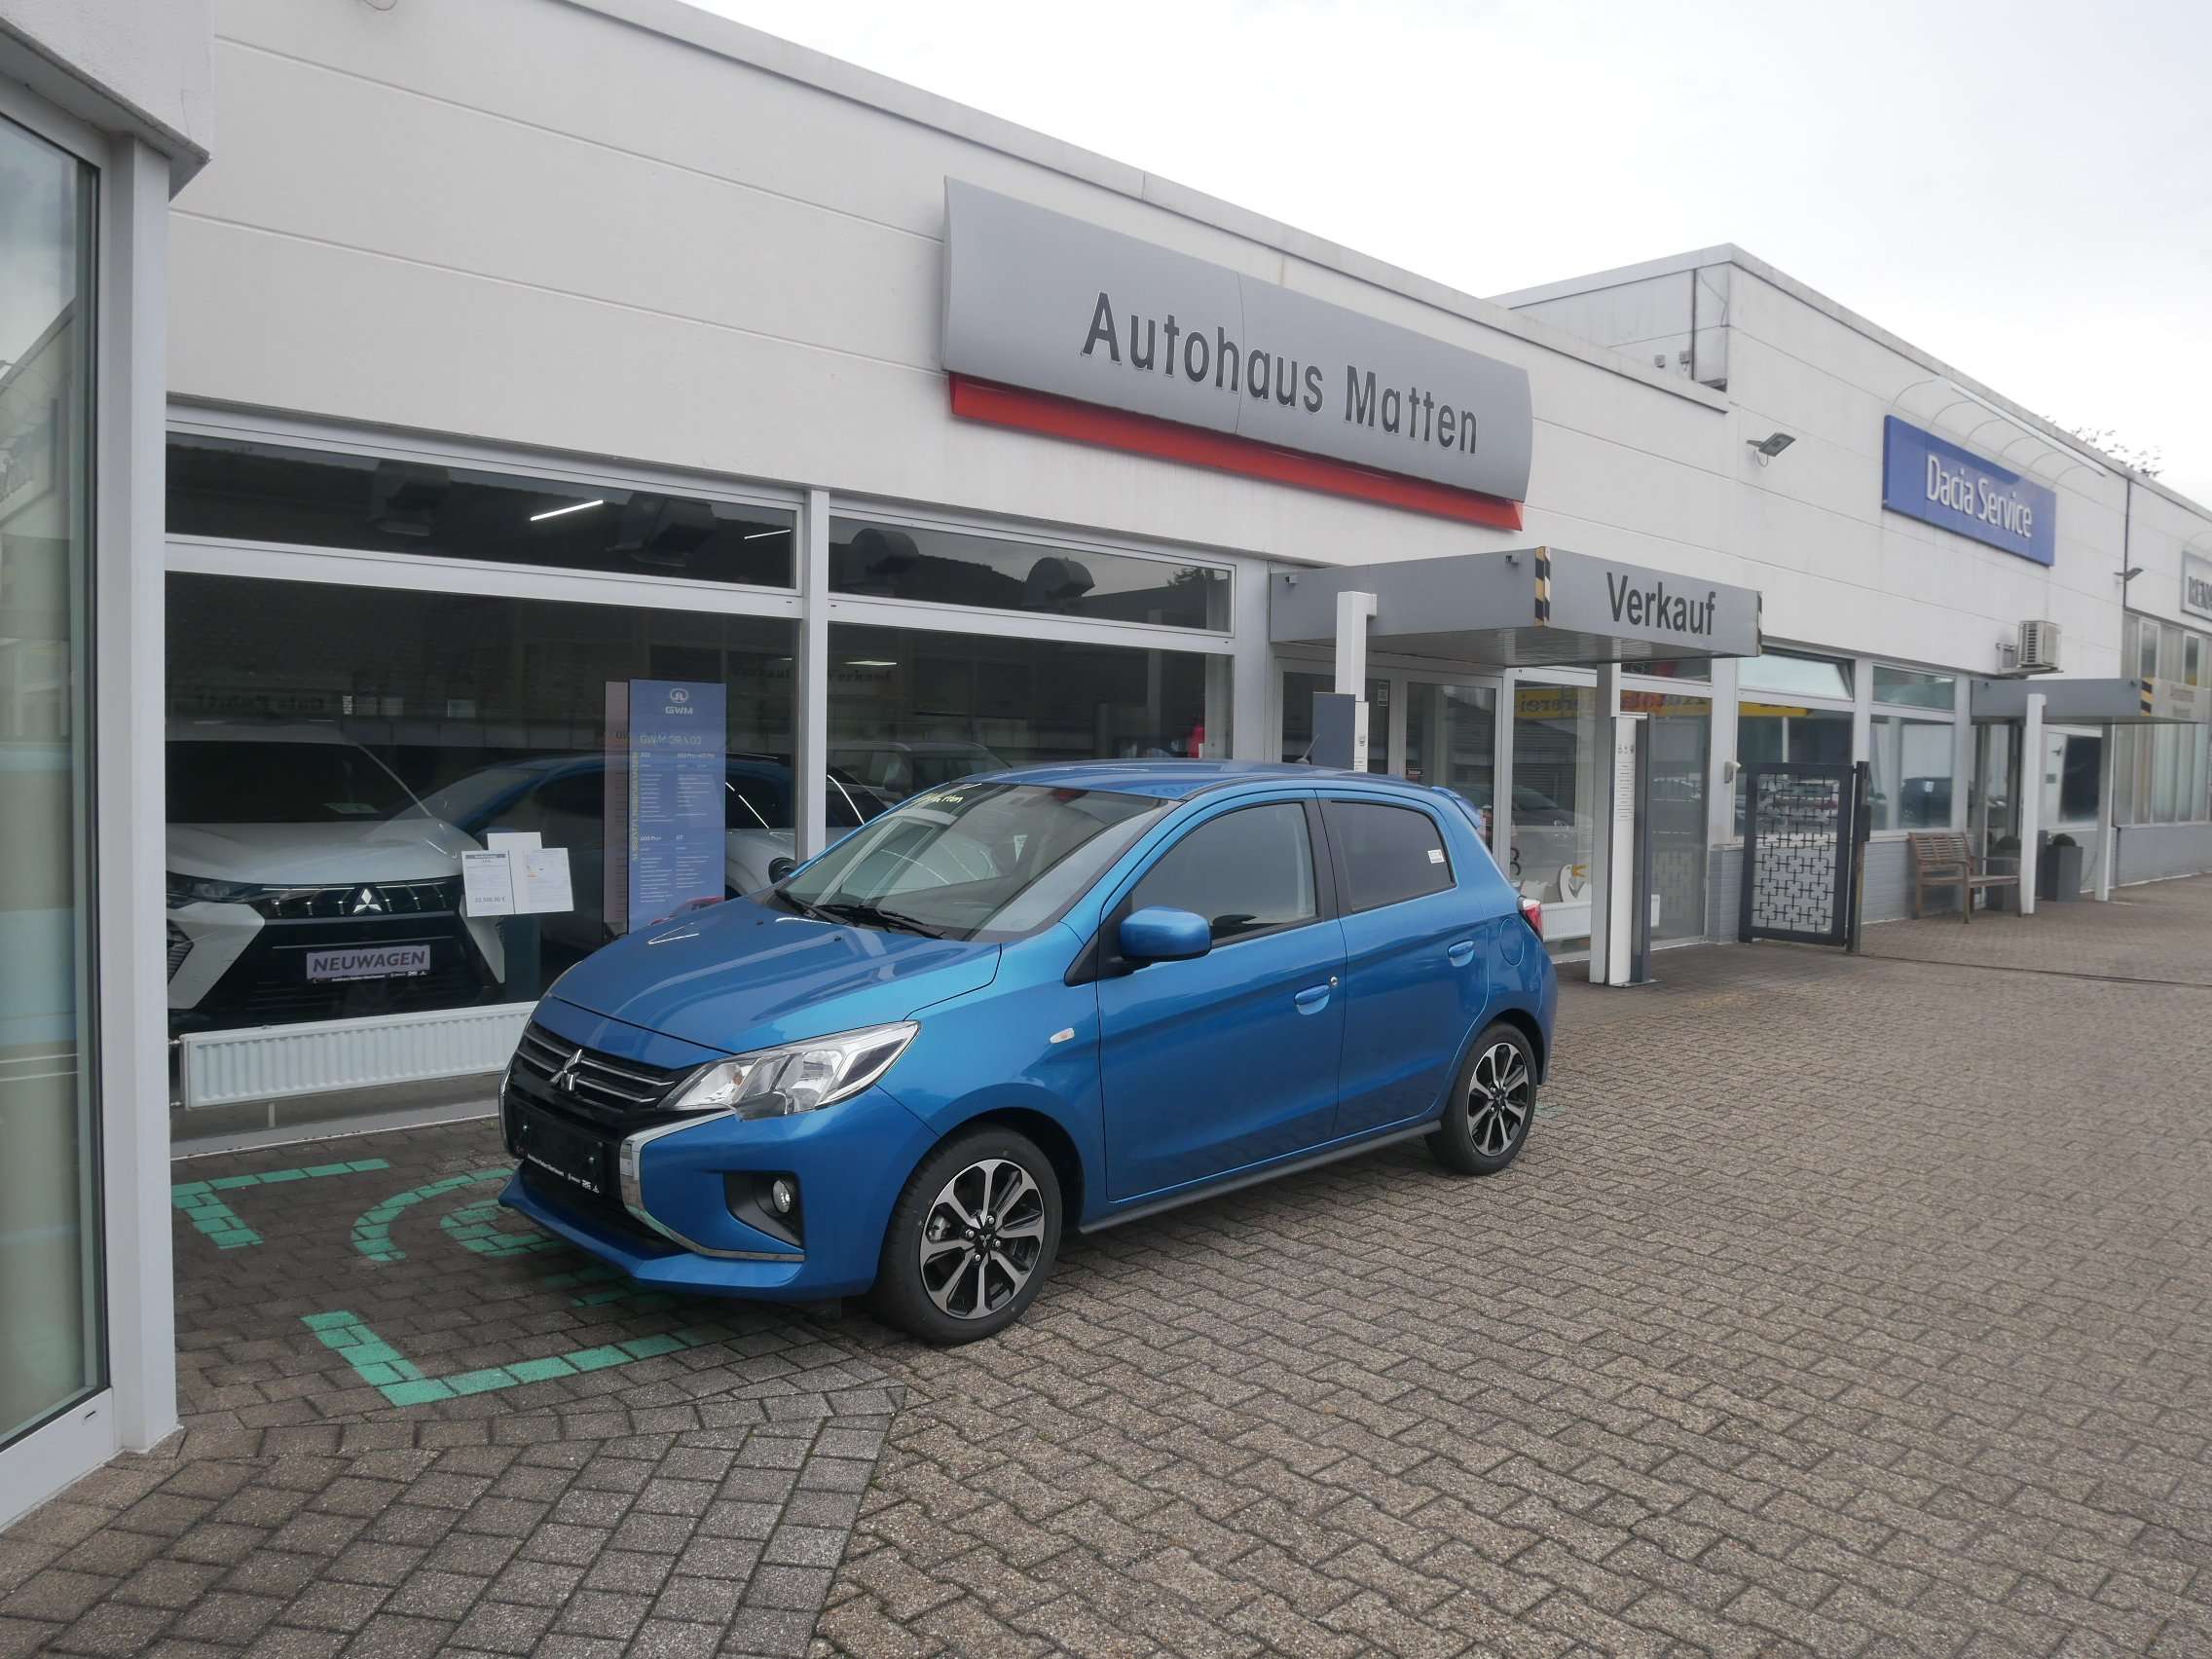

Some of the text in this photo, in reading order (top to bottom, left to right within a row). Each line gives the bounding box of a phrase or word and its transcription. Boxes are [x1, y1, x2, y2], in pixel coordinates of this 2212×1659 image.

[1081, 291, 1477, 454] Autohaus Matten
[1926, 454, 2033, 537] Dacia Service
[1606, 571, 1716, 635] Verkauf
[665, 706, 693, 716] GWM
[313, 950, 426, 972] NEUWAGEN
